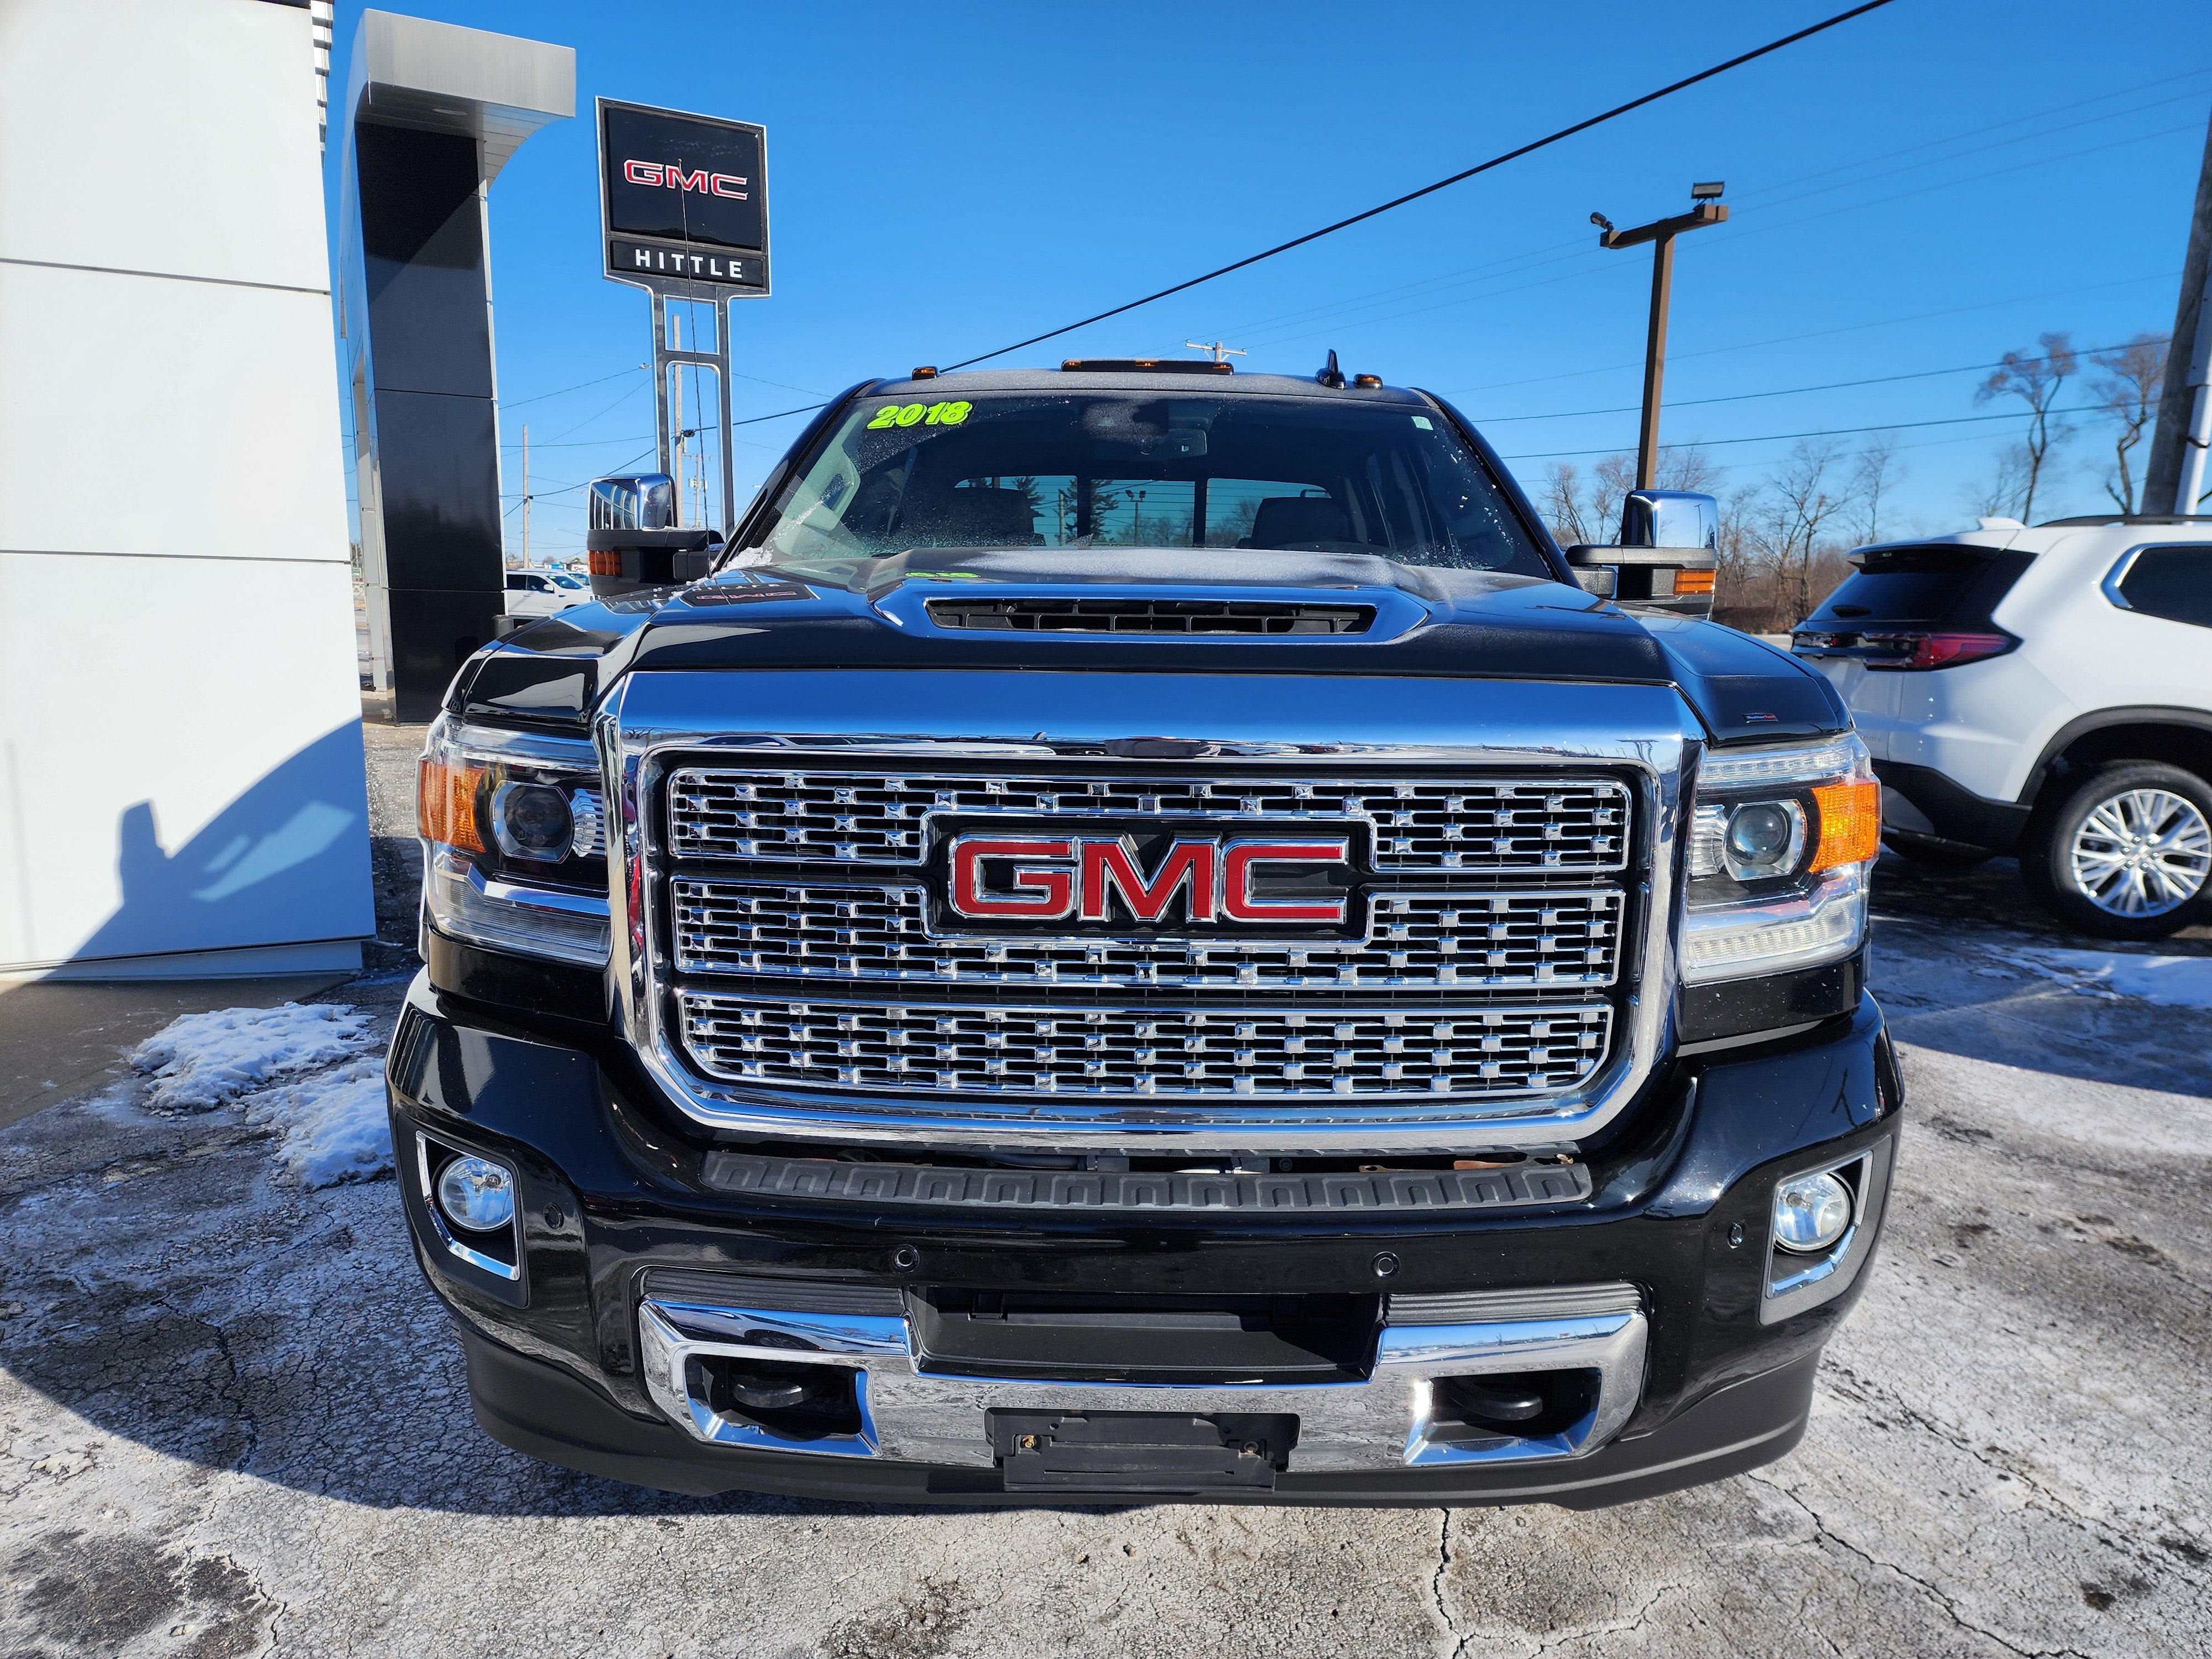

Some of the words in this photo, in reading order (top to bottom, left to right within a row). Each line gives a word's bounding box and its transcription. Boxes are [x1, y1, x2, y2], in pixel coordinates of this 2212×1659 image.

[623, 159, 749, 201] GMC
[635, 249, 743, 279] HITTLE
[867, 401, 973, 429] 2018
[948, 833, 1349, 924] GMC
